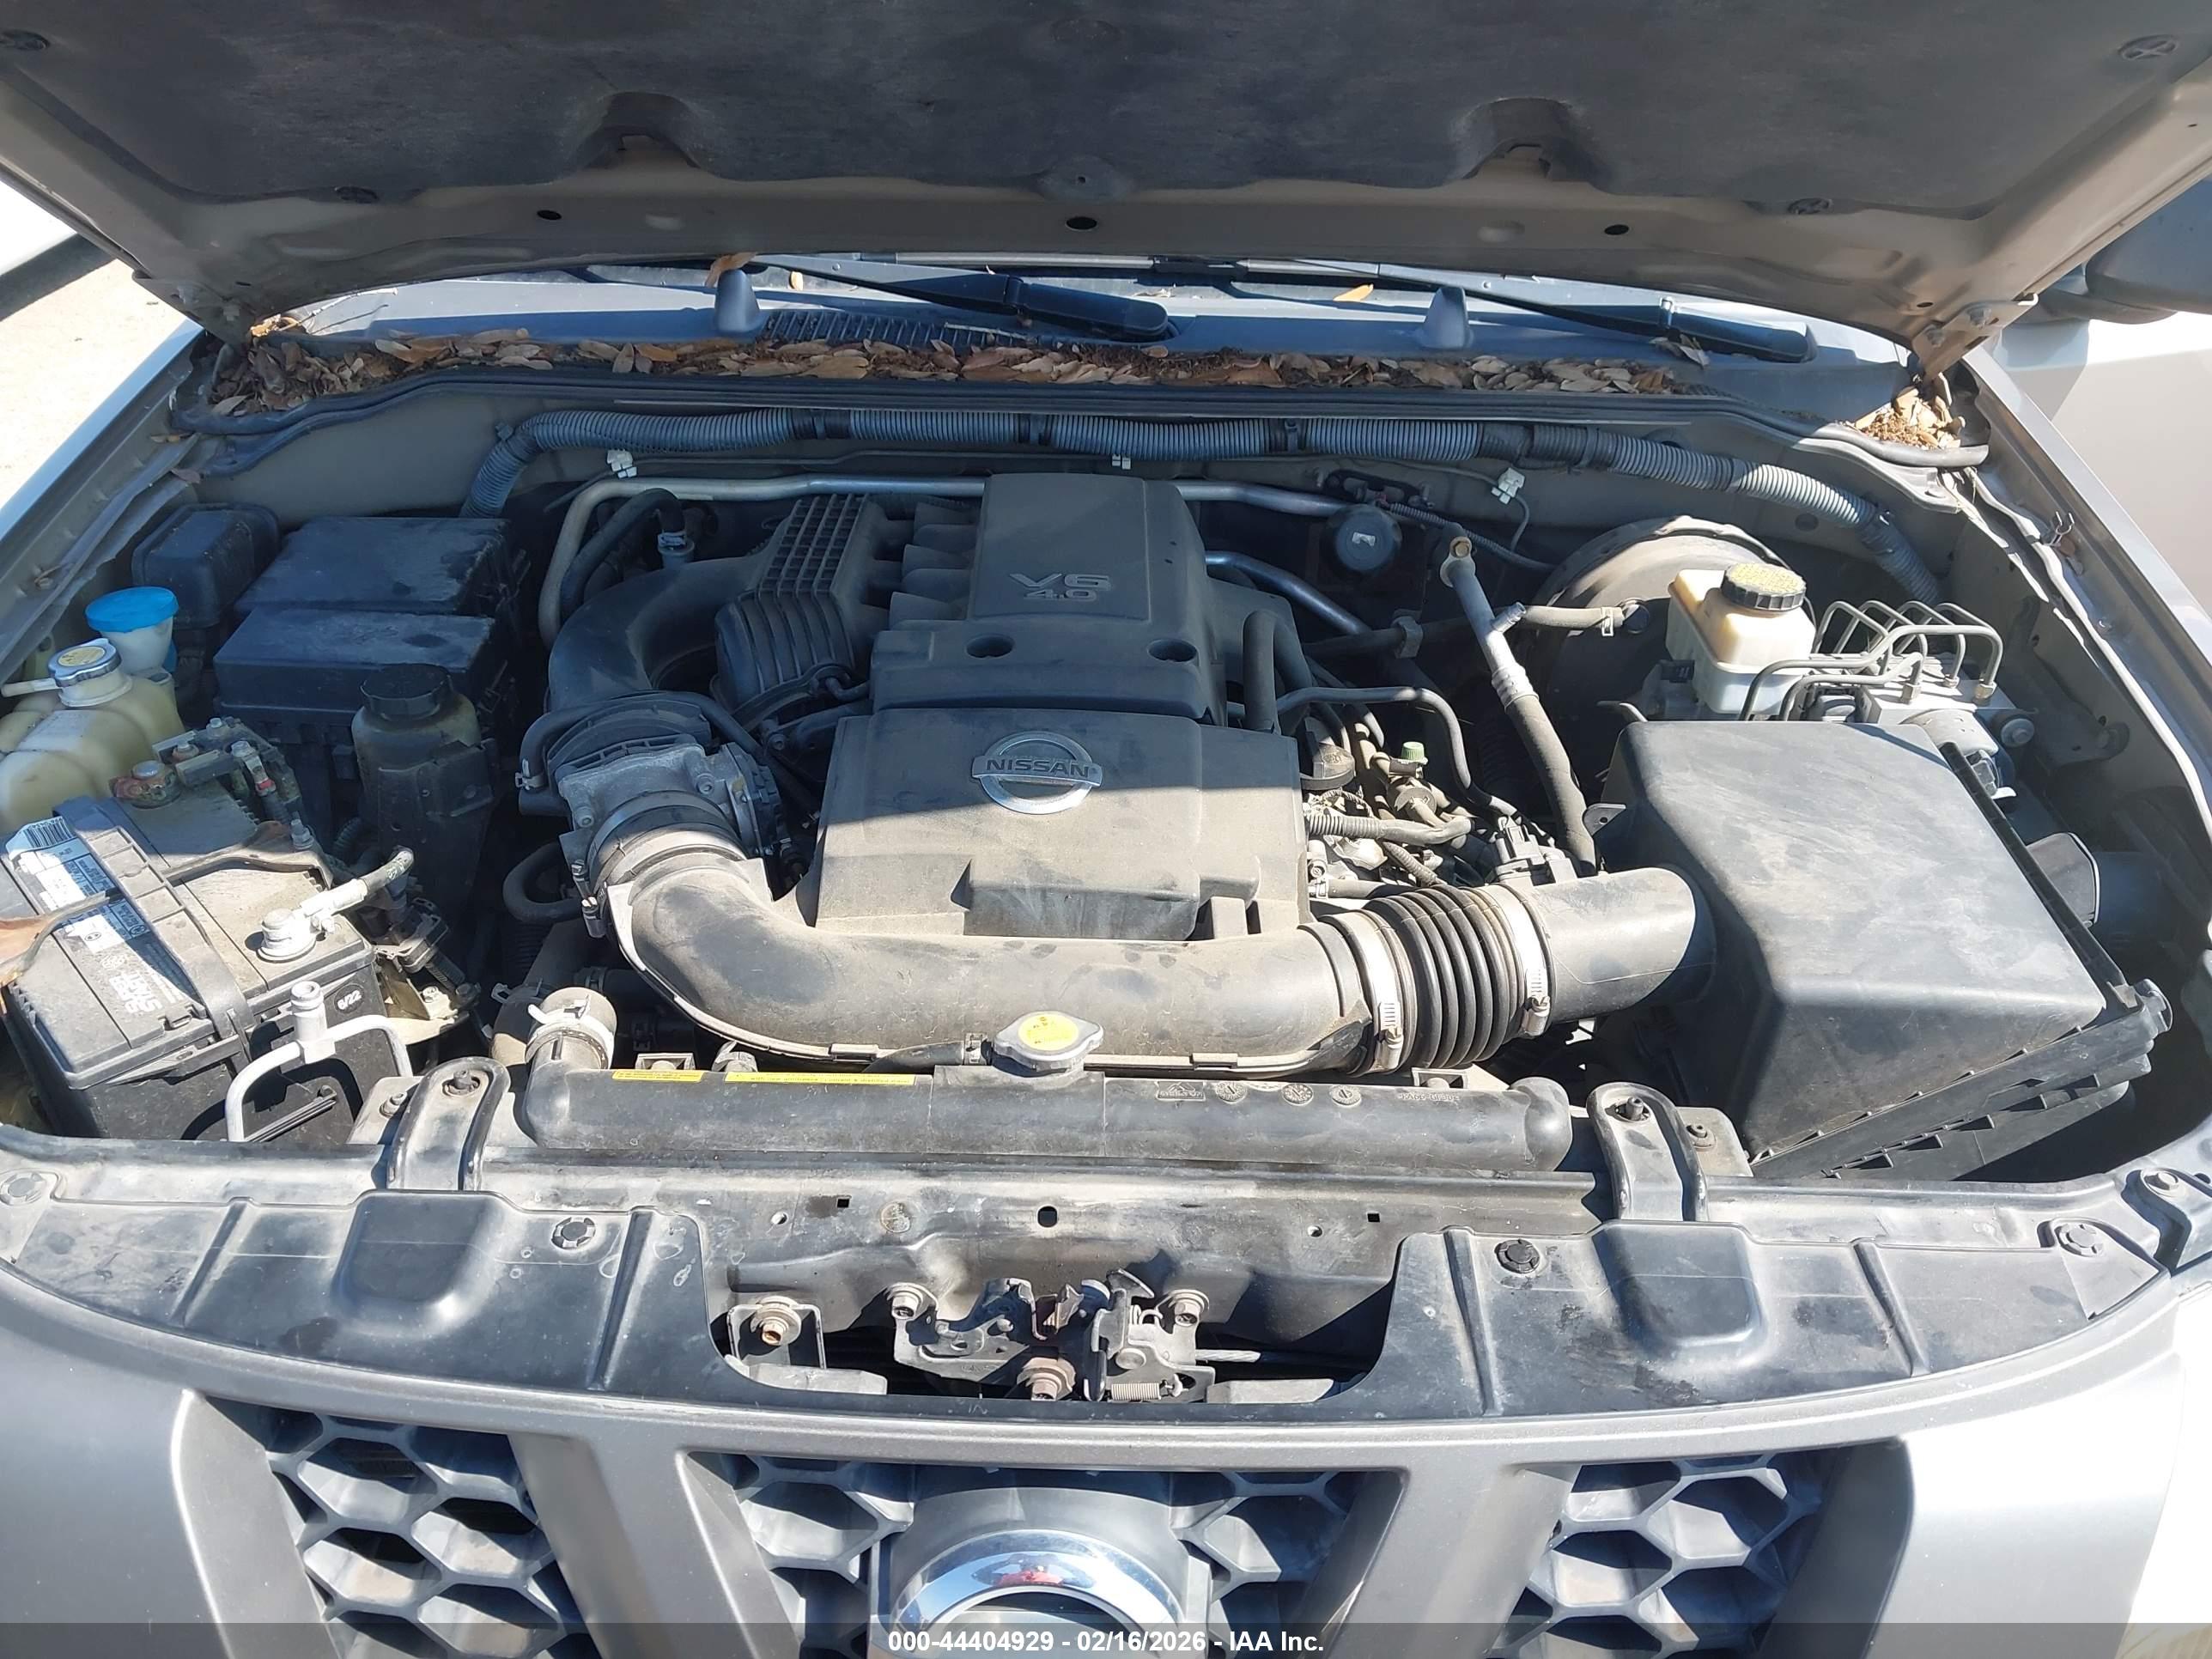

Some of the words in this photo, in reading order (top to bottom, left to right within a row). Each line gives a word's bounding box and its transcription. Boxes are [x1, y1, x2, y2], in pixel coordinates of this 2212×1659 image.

[1008, 573, 1111, 591] V6
[1024, 588, 1097, 602] 4.0
[986, 758, 1090, 778] NISSAN
